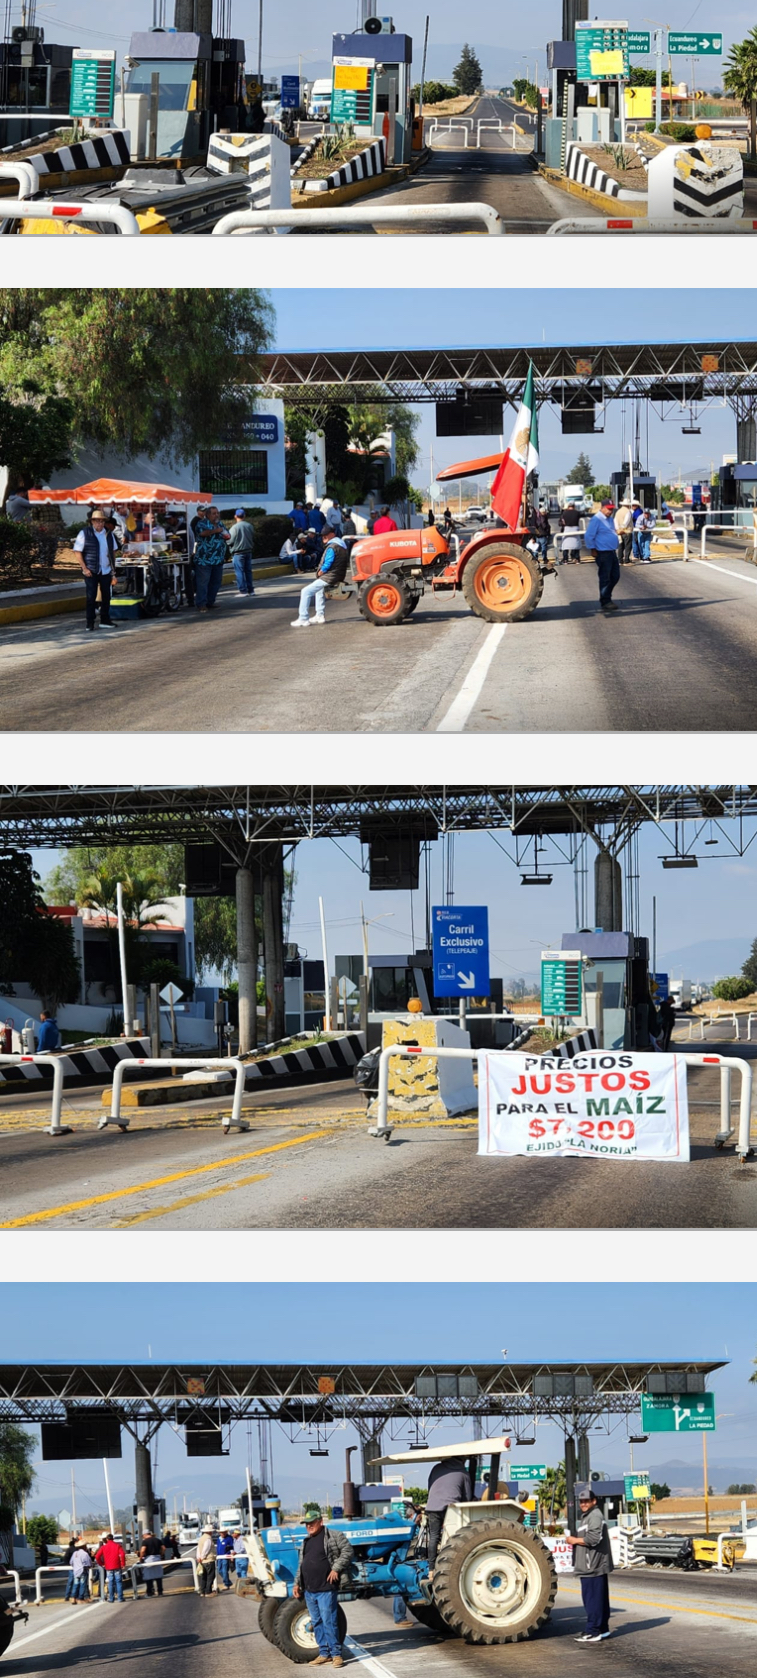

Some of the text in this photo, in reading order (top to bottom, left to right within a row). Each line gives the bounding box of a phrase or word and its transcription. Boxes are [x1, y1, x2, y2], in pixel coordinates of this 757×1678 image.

[449, 924, 475, 934] Carril
[440, 936, 484, 947] Exclusivo
[524, 1055, 633, 1071] PRECIOS
[511, 1070, 651, 1095] JUSTOS
[496, 1092, 667, 1116] PARA EL MAÍZ
[528, 1118, 636, 1141] $7,200
